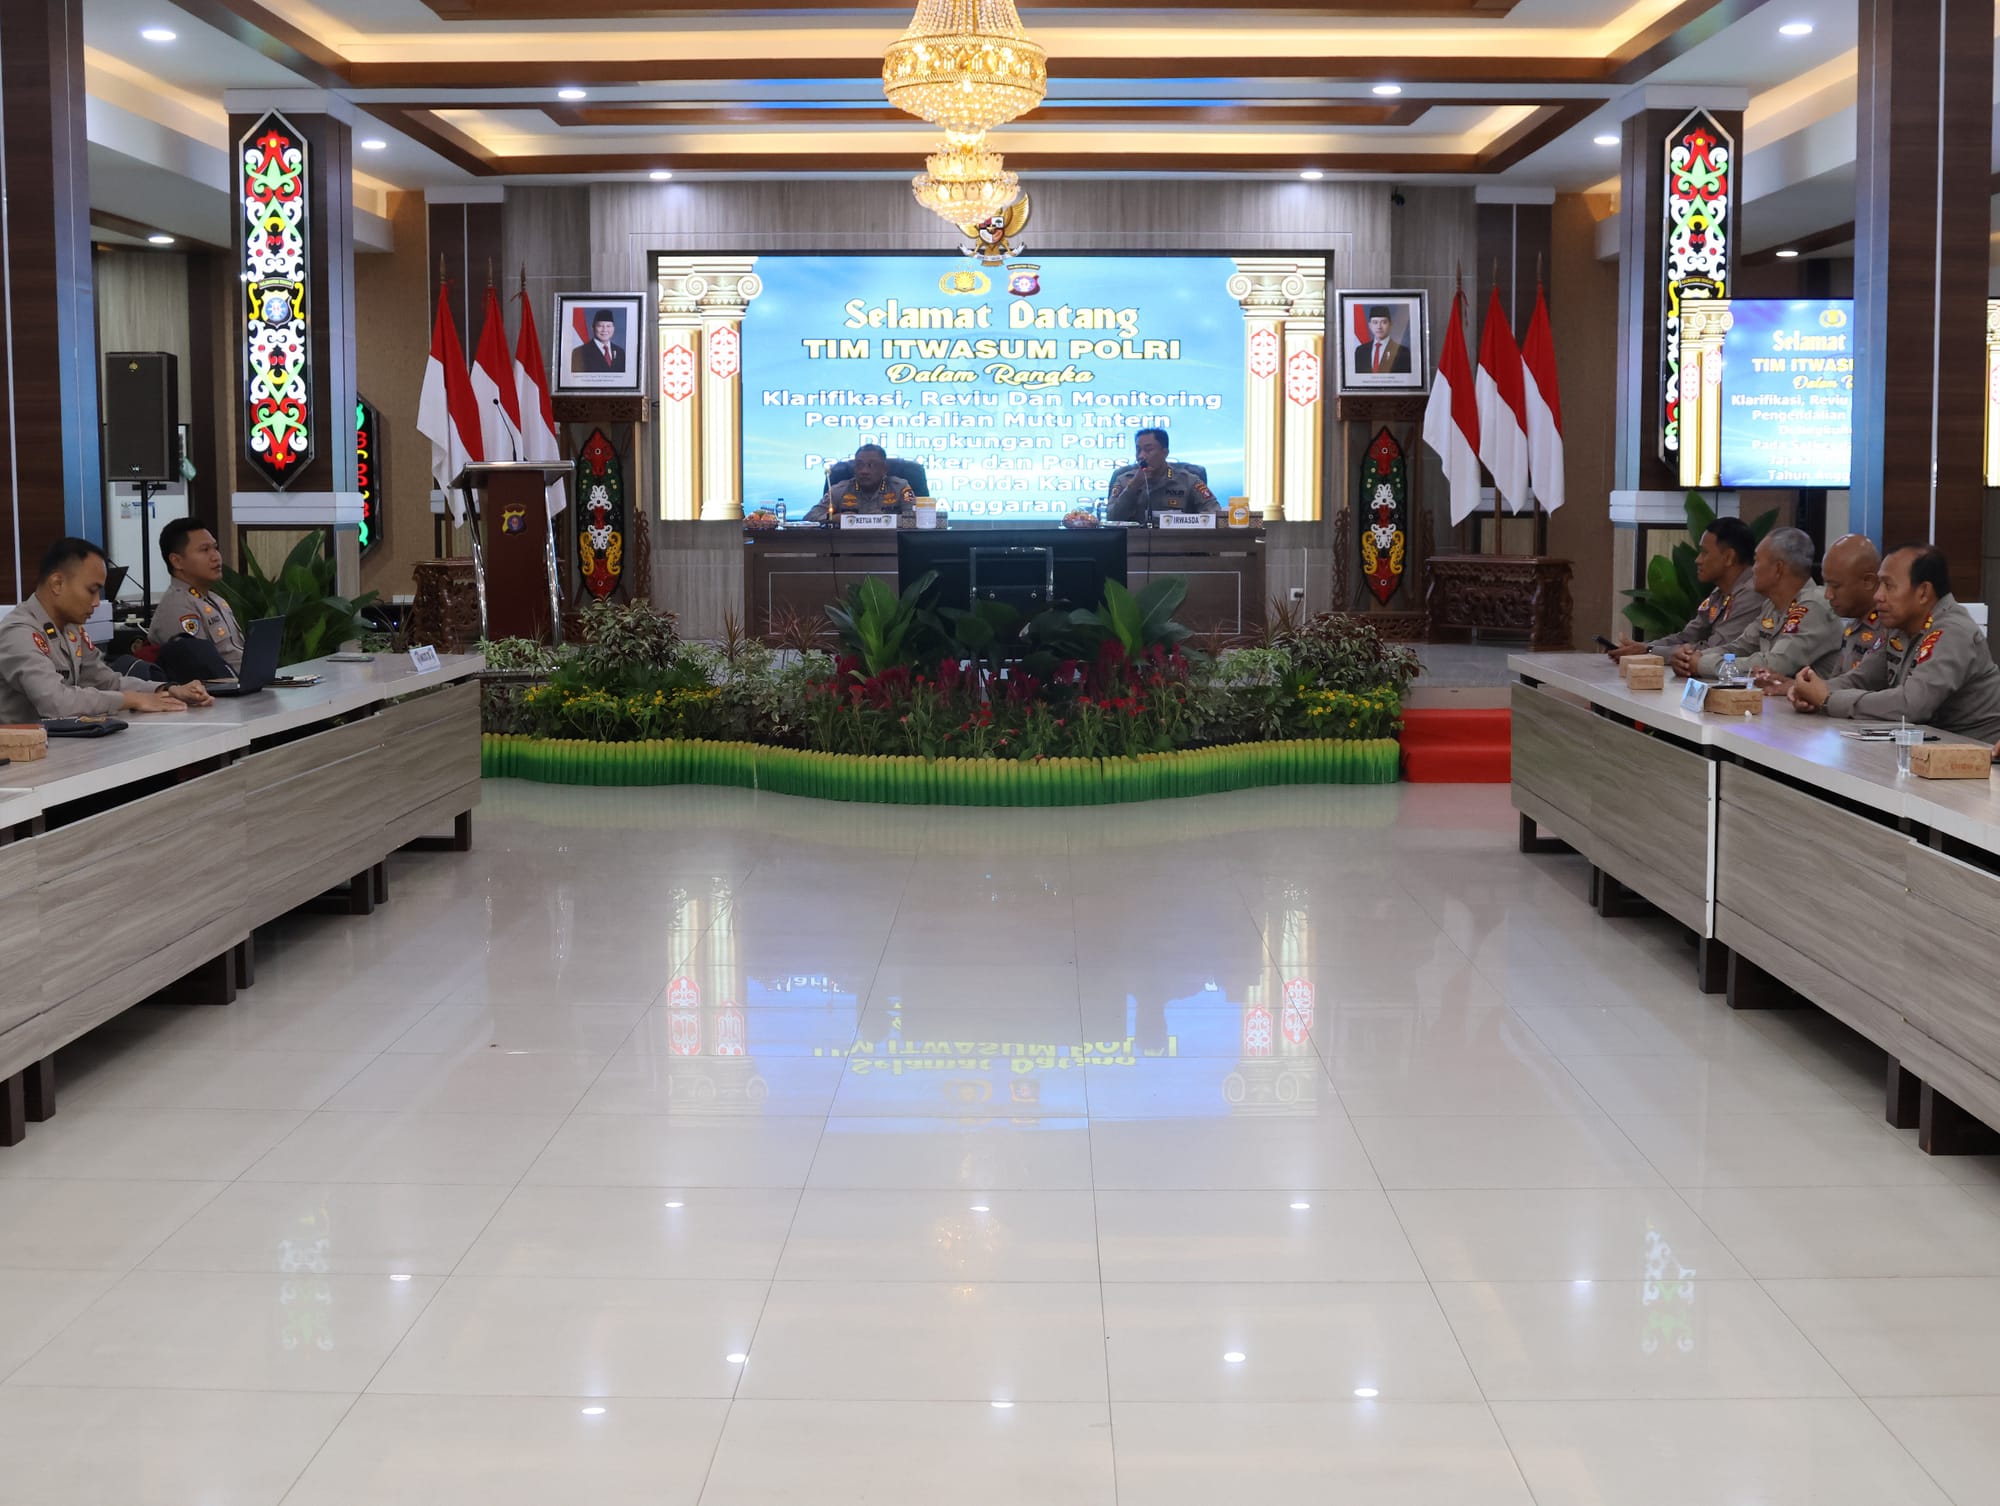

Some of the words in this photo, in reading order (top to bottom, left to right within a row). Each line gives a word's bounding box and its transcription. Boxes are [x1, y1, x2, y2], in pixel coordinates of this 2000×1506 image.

[844, 298, 992, 329] Selamat
[1009, 299, 1139, 338] Datang
[802, 339, 870, 359] TIM
[882, 339, 1057, 359] ITWASUM
[1069, 339, 1181, 360] POLRI
[1773, 330, 1846, 351] Selamat
[1752, 358, 1786, 372] TIM
[885, 363, 979, 384] Dalam
[983, 363, 1095, 390] Rangka
[762, 390, 912, 408] Klarifikasi,
[921, 391, 998, 406] Reviu
[1008, 391, 1062, 407] Dan
[1072, 391, 1222, 409] Monitoring
[805, 412, 994, 429] Pengendalian
[1004, 413, 1072, 428] Mutu
[1082, 412, 1171, 428] Intern
[897, 433, 1052, 451] lingkungan
[1062, 433, 1126, 449] Polri
[981, 454, 1033, 470] dan
[953, 475, 1030, 492] Polda
[935, 497, 1067, 515] Anggaran
[1173, 516, 1200, 525] IRWASDA
